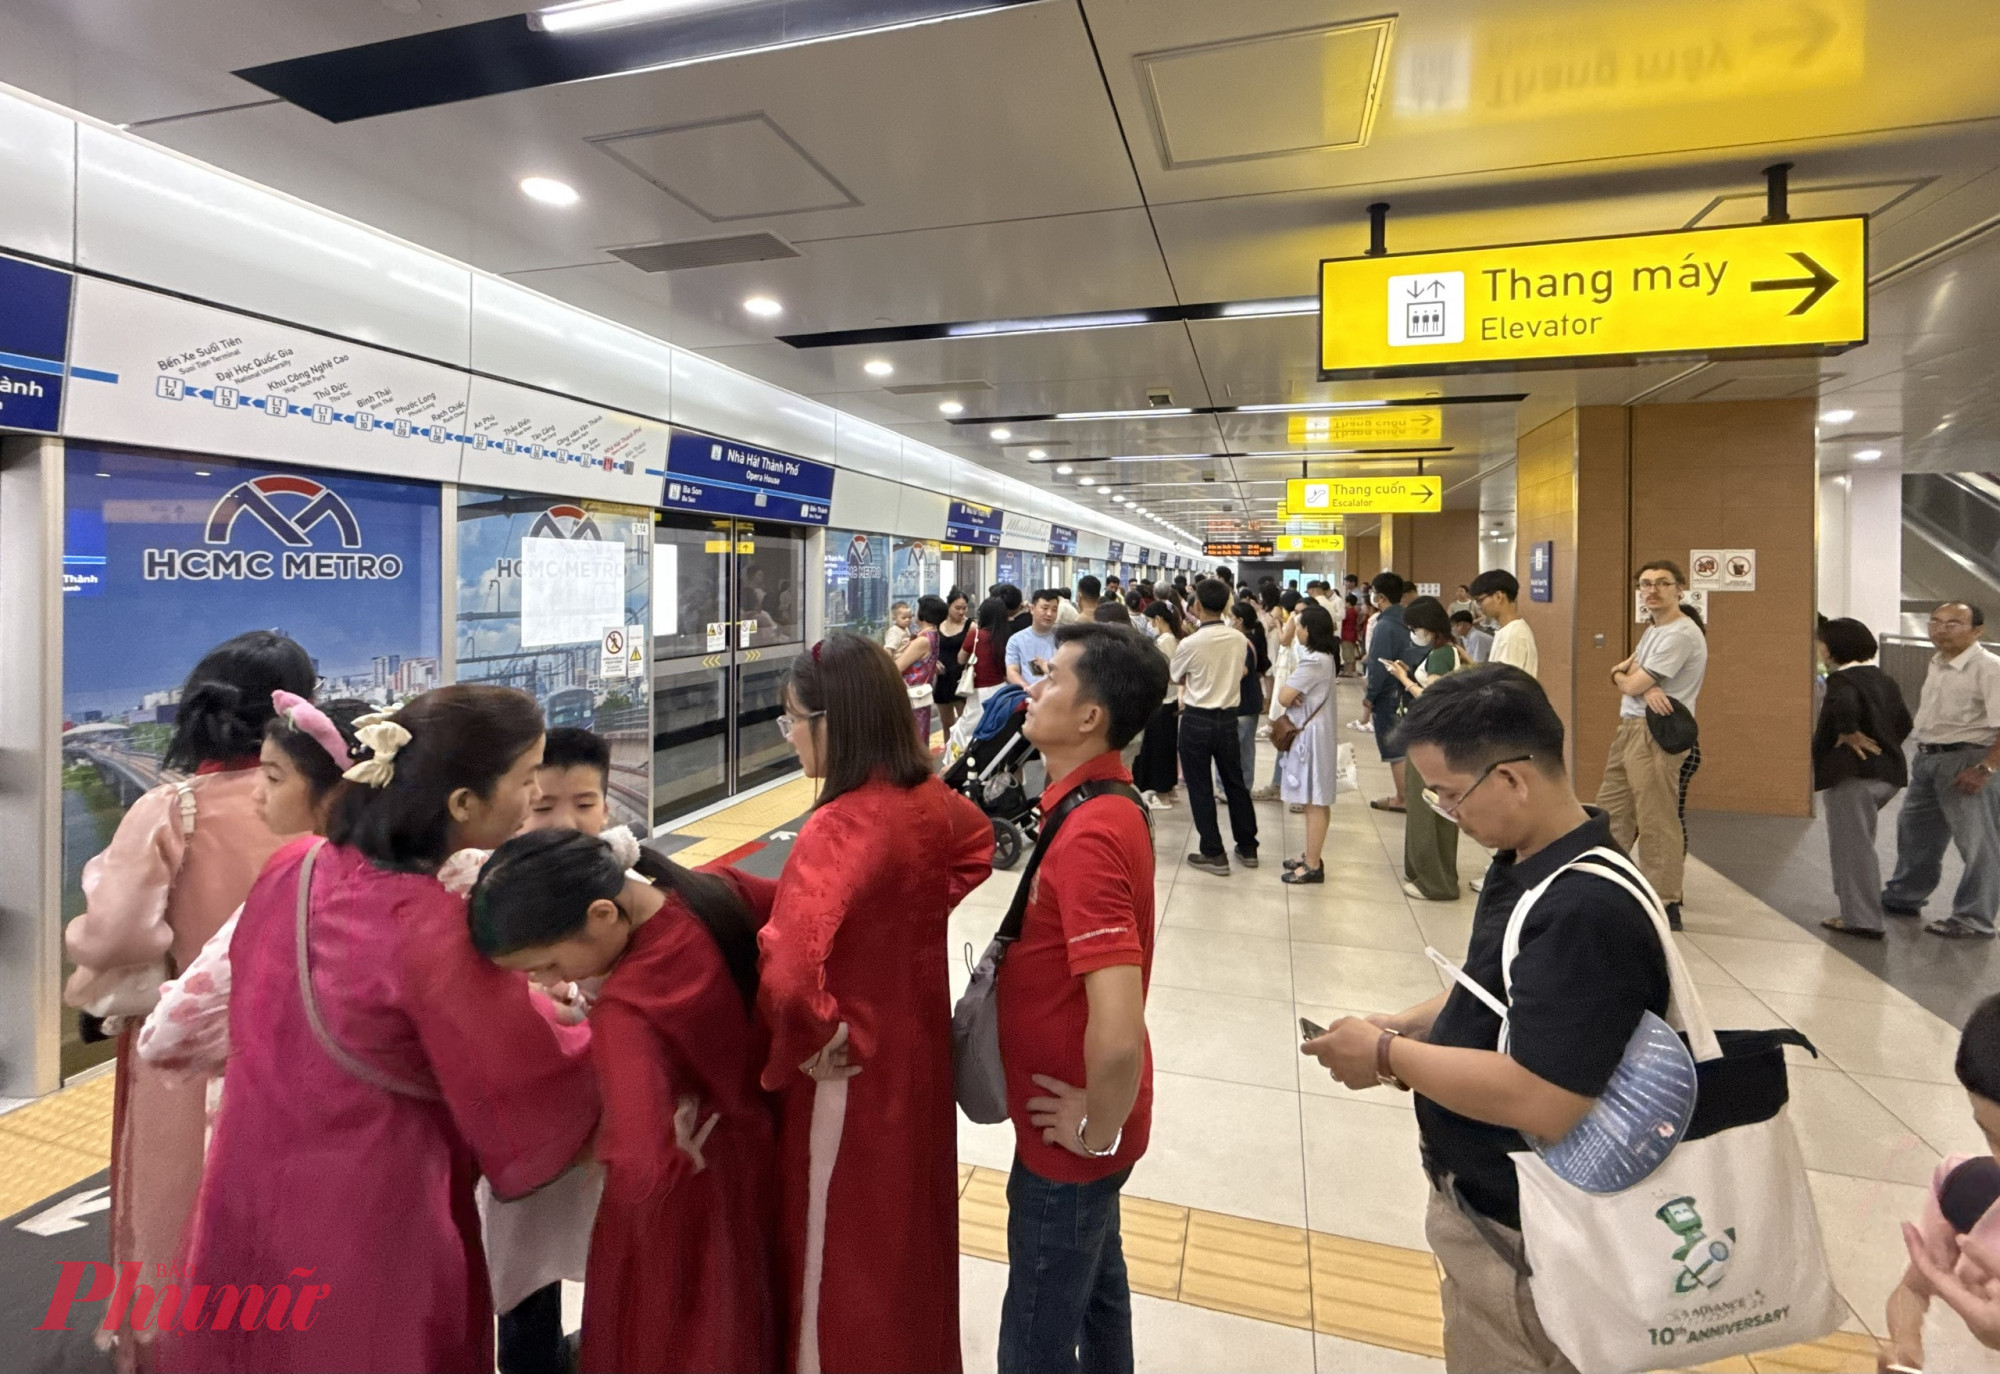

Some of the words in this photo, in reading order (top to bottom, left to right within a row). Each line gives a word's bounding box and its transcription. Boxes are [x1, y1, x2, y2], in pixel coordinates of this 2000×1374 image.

[1481, 267, 1613, 304] Thang
[1632, 252, 1728, 297] máy
[1481, 313, 1603, 341] Elevator
[157, 356, 181, 371] Bến
[181, 351, 196, 363] Xe
[196, 342, 221, 357] Suối
[220, 336, 243, 350] Tiên
[178, 364, 196, 375] Suoi
[196, 359, 211, 369] Tien
[211, 349, 241, 364] Terminal
[216, 369, 233, 382] Đại
[234, 362, 253, 375] Học
[253, 351, 277, 367] Quốc
[278, 347, 294, 359] Gia
[235, 371, 260, 384] National
[261, 359, 291, 375] University
[267, 377, 287, 391] Khu
[288, 369, 310, 384] Công
[310, 358, 333, 375] Nghệ
[334, 353, 349, 365] Cao
[165, 379, 177, 388] L1
[284, 384, 299, 394] High
[300, 378, 312, 388] Tech
[312, 374, 326, 384] Park
[165, 387, 176, 397] 14
[221, 389, 232, 398] L1
[313, 384, 331, 400] Thủ
[331, 381, 348, 393] Đức
[221, 398, 231, 407] 13
[272, 398, 283, 407] L1
[418, 392, 437, 405] Long
[272, 406, 281, 415] 12
[318, 407, 328, 415] L1
[319, 414, 326, 422] 11
[360, 414, 369, 422] L1
[360, 421, 368, 429] 10
[398, 428, 406, 436] 09
[433, 434, 441, 442] 08
[727, 449, 746, 464] Nhà
[746, 453, 761, 468] Hát
[762, 456, 784, 472] Thành
[785, 461, 800, 476] Phố
[746, 470, 764, 483] Opera
[763, 475, 780, 485] House
[683, 485, 691, 494] Ba
[691, 486, 703, 496] Son
[1332, 484, 1372, 497] Thang
[1375, 481, 1406, 495] cuốn
[1332, 499, 1373, 507] Escalator
[634, 523, 647, 534] 2-14
[1203, 545, 1208, 554] 2
[144, 549, 273, 580] HCMC
[283, 550, 403, 580] METRO
[859, 566, 881, 579] METRO
[1686, 1305, 1791, 1344] ANNIVERSARY
